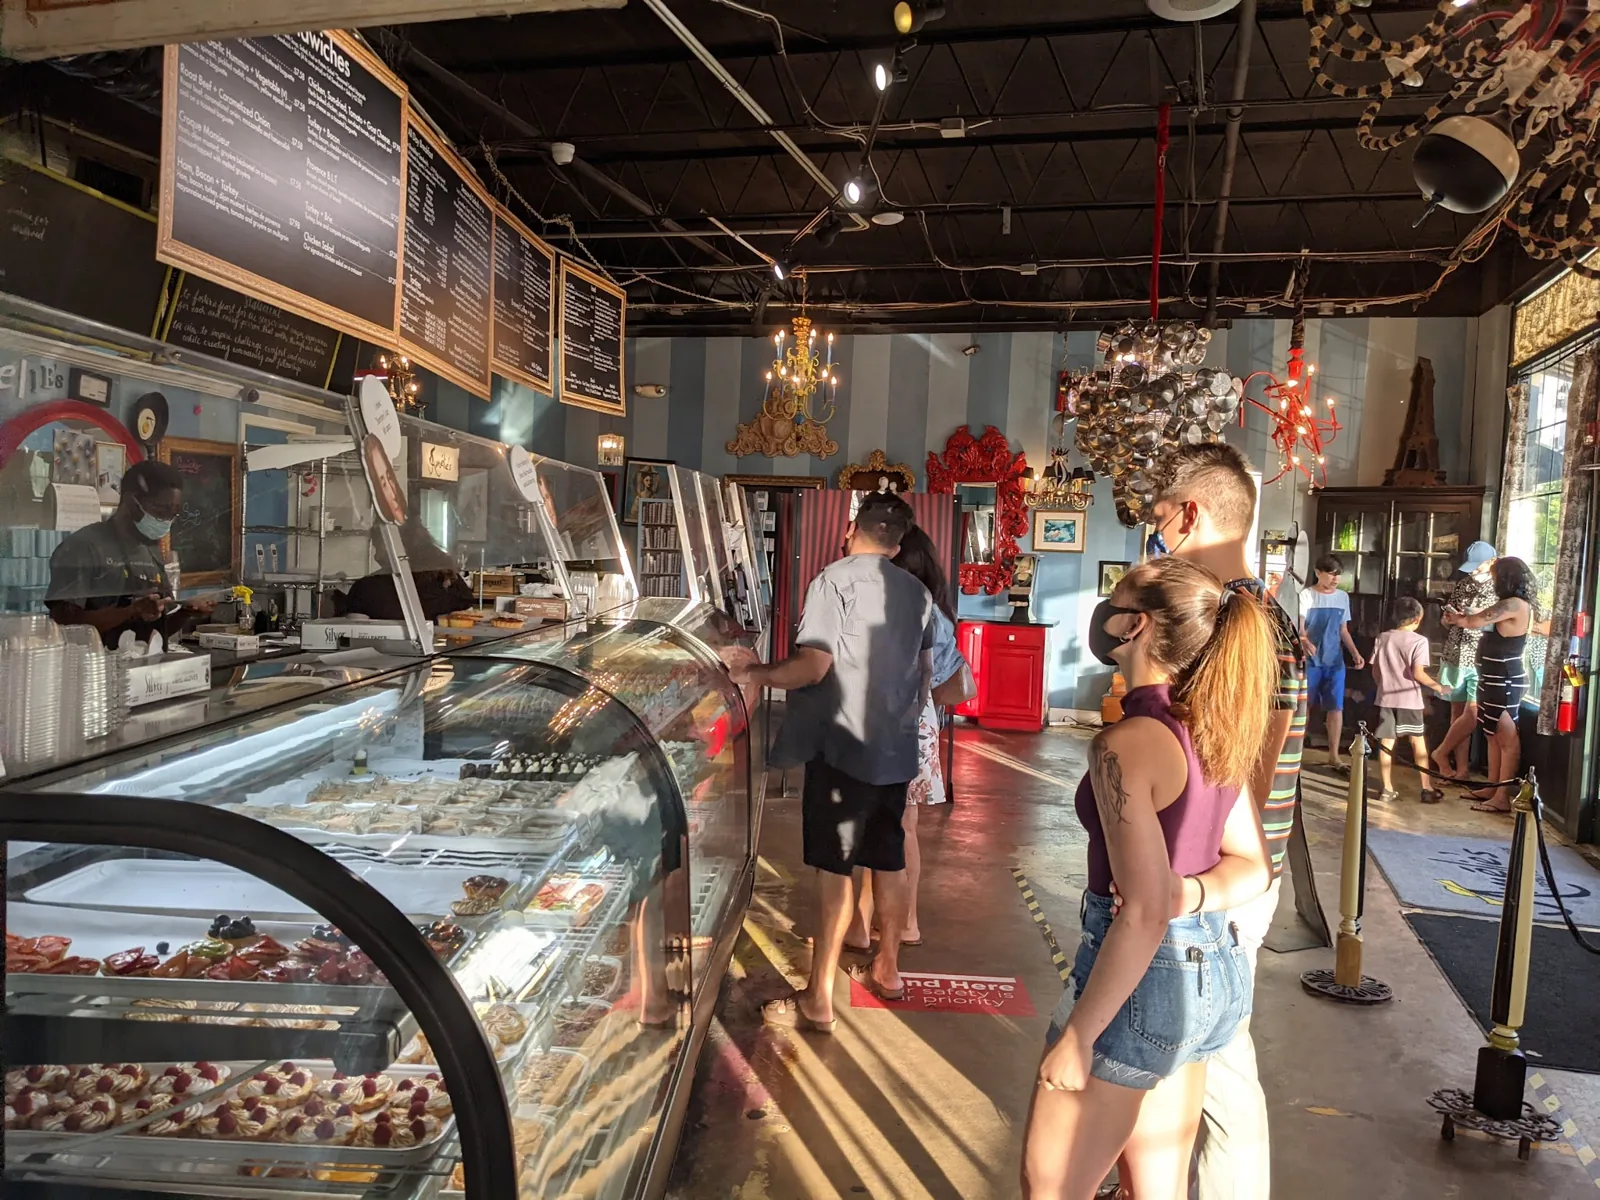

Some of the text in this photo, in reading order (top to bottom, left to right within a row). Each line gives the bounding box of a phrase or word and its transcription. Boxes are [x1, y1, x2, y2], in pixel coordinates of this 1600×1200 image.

[225, 46, 249, 73] Hummus
[254, 66, 280, 97] Vegetable
[180, 60, 197, 82] Roast
[198, 72, 212, 92] Beef
[218, 85, 253, 119] Caramelized
[253, 109, 270, 130] Onion
[308, 74, 326, 98] Chicken,
[348, 105, 362, 124] Tomato
[366, 119, 376, 135] Goat
[376, 127, 390, 145] Cheese
[178, 107, 201, 134] Croque
[202, 123, 230, 149] Monsieur
[307, 114, 322, 136] Turkey
[326, 128, 340, 146] Bacon
[176, 155, 194, 175] Ham,
[195, 164, 214, 185] Bacon
[220, 177, 238, 200] Turkey
[306, 156, 326, 178] Provence
[304, 199, 319, 220] Turkey
[324, 211, 333, 224] Brie
[303, 229, 321, 248] Chicken
[321, 238, 334, 254] Salad
[922, 987, 989, 998] safety
[998, 990, 1014, 999] is
[951, 981, 1015, 992] Here
[923, 996, 1005, 1008] priority
